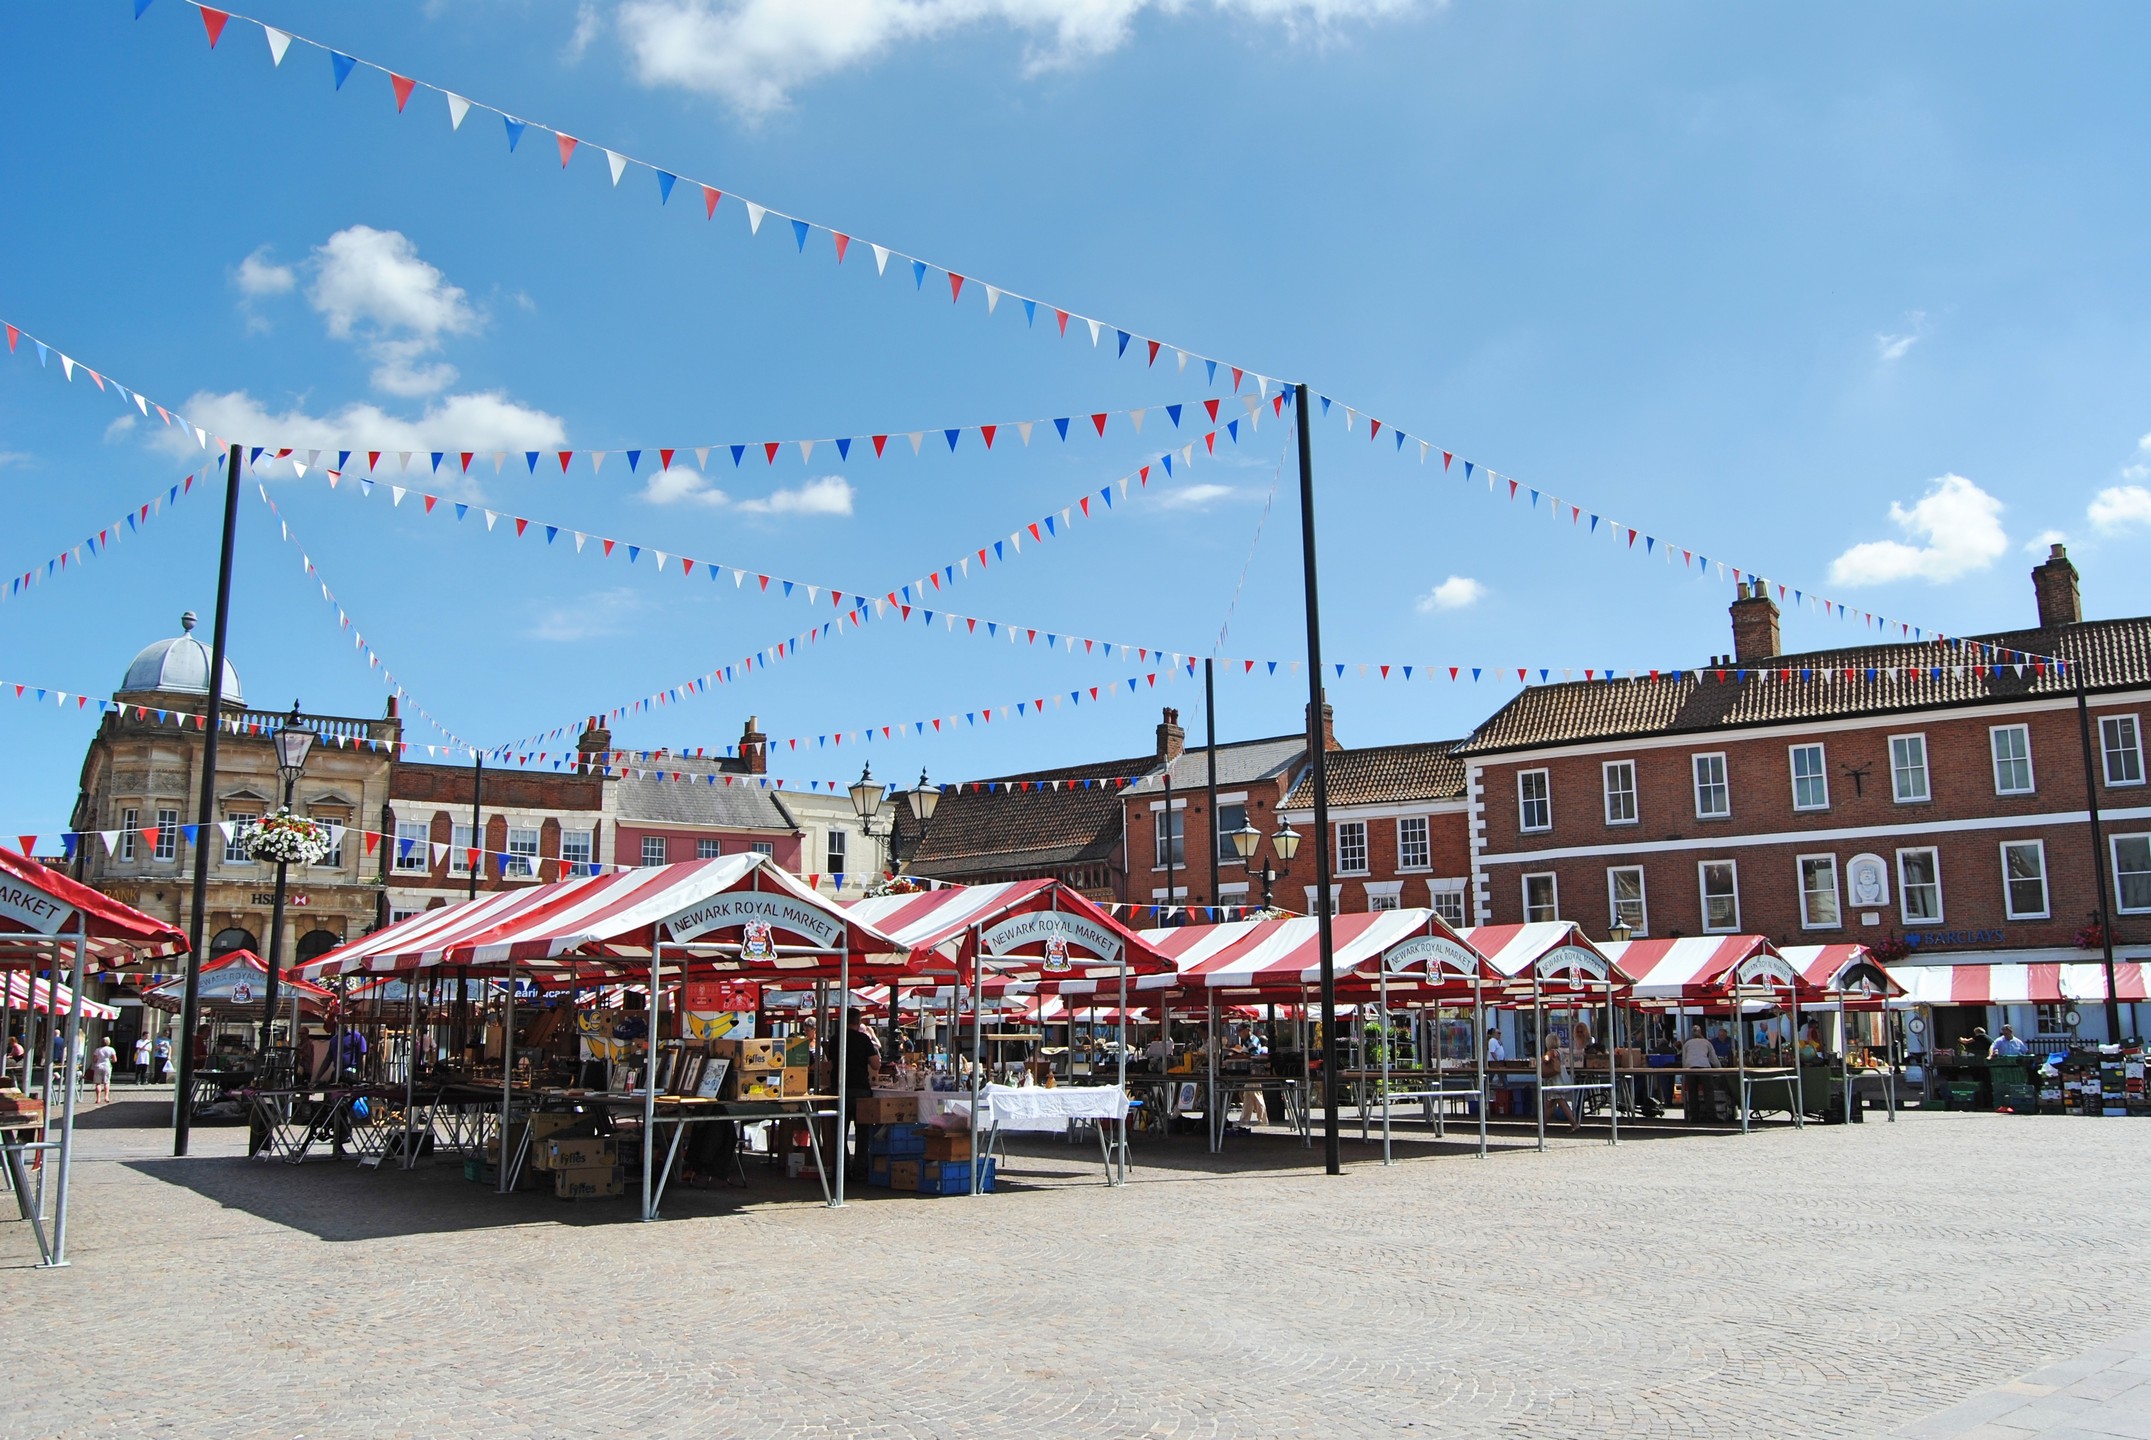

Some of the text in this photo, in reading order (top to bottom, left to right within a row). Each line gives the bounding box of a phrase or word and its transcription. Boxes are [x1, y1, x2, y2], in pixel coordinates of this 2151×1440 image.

[0, 886, 61, 920] ARKET
[674, 901, 833, 938] NEWARK ROYAL MARKET
[992, 919, 1115, 952] NEWARK ROYAL MARKET
[1924, 928, 2006, 945] BARCLAYS
[1391, 943, 1471, 969] NEWARK ROYAL MARKET
[1542, 954, 1564, 973] NEWARK
[1564, 951, 1583, 962] ROYAL
[199, 973, 227, 988] EWARK
[229, 972, 255, 980] ROYAL
[560, 1152, 586, 1166] fyffes
[569, 1182, 597, 1197] fyffes
